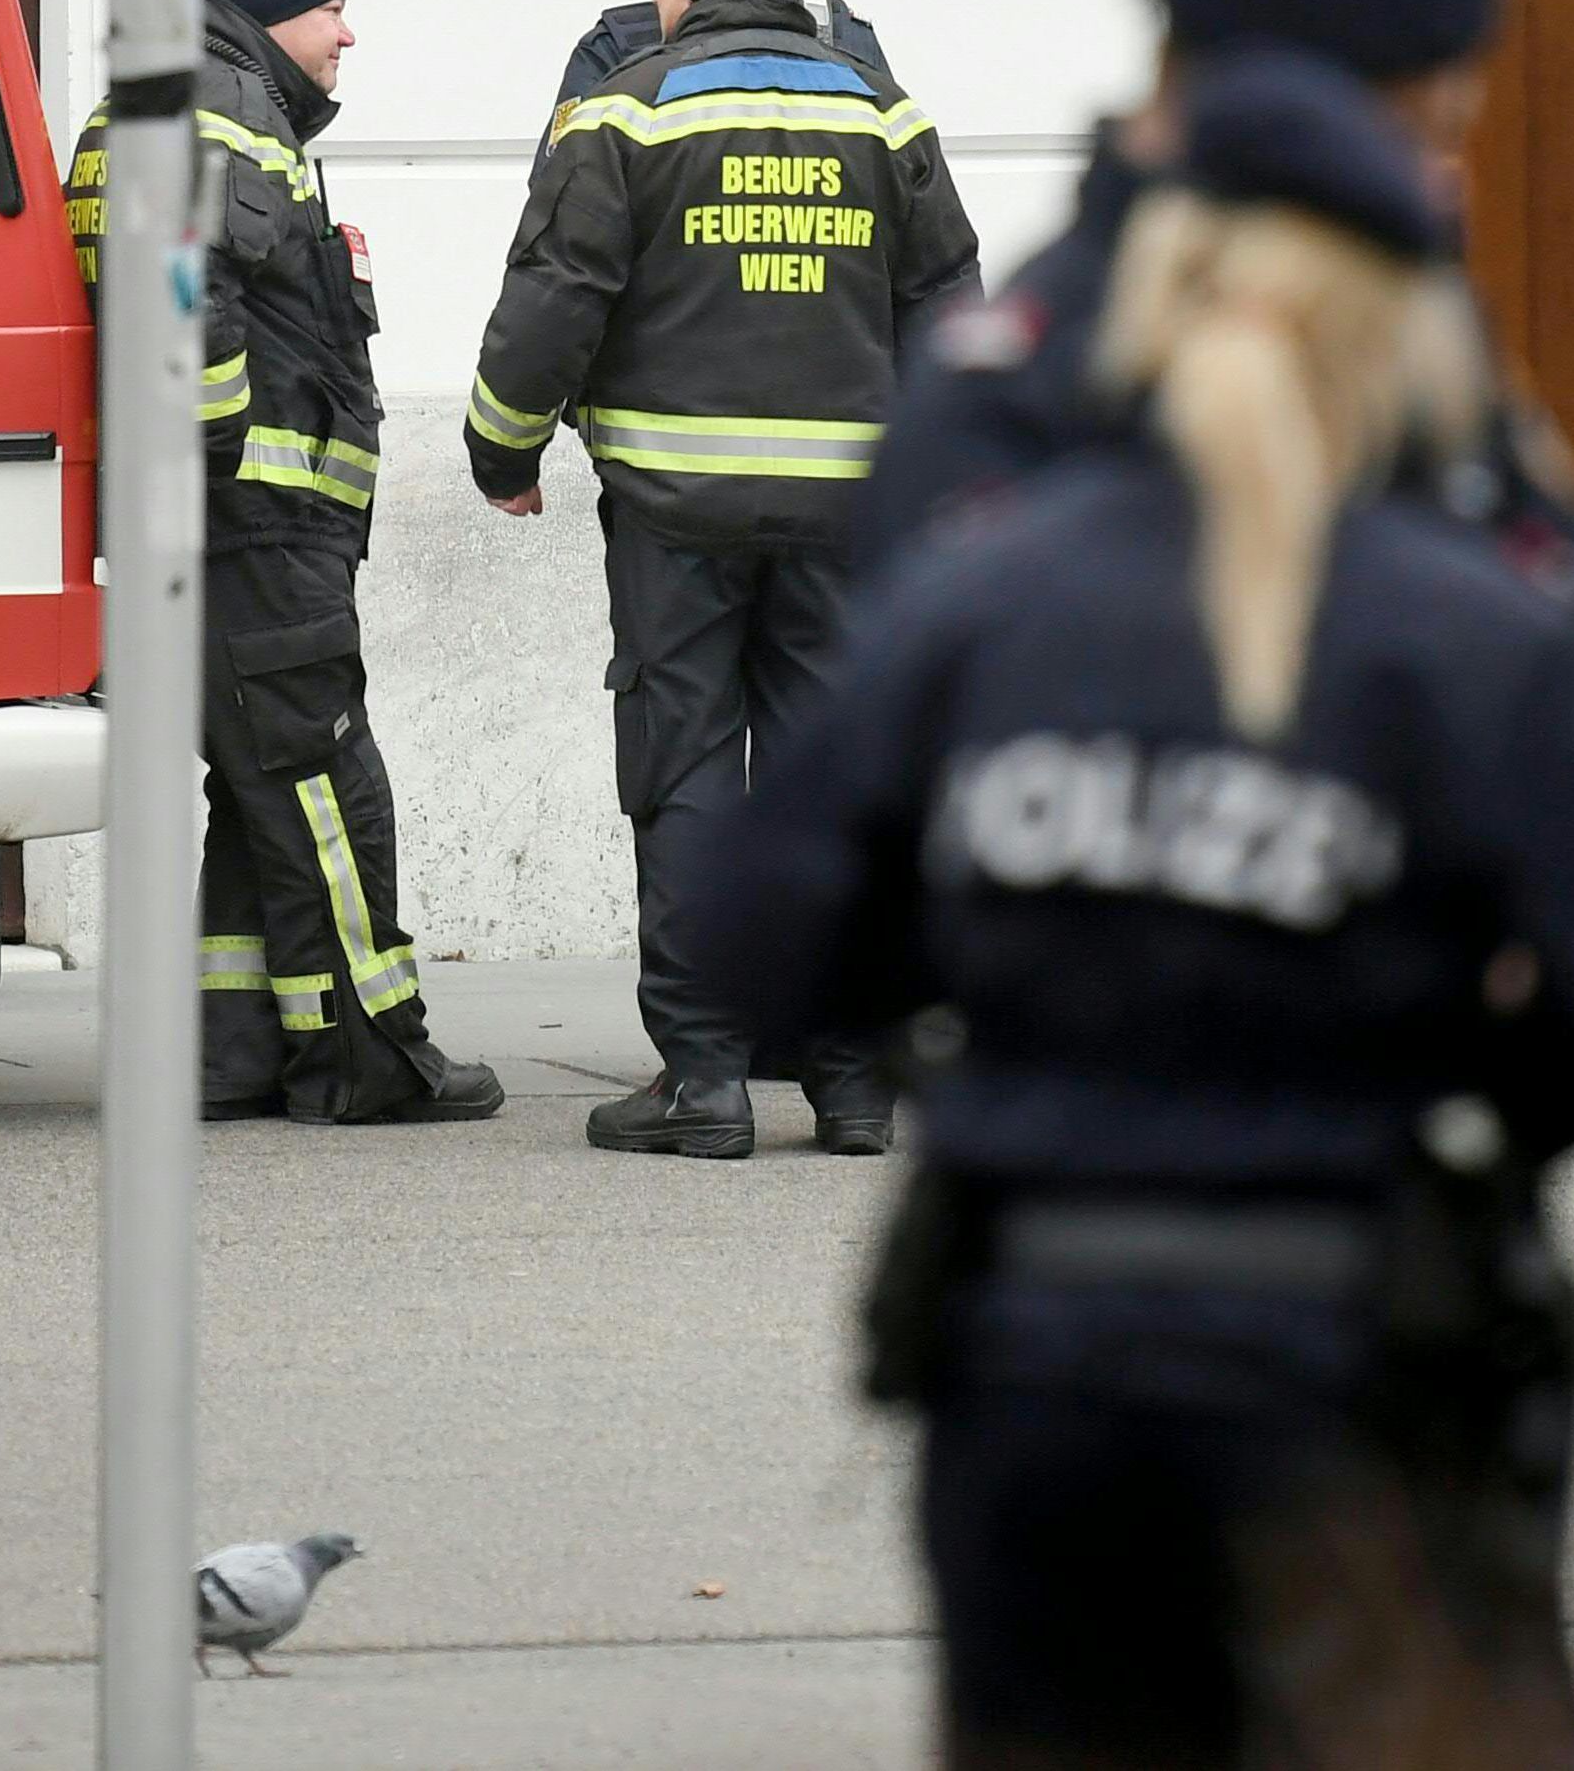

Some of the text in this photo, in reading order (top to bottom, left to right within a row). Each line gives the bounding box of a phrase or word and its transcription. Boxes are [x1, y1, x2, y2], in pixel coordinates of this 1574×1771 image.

[721, 155, 842, 197] BERUFS
[683, 204, 875, 248] FEUERWEHR
[739, 253, 825, 294] WIEN
